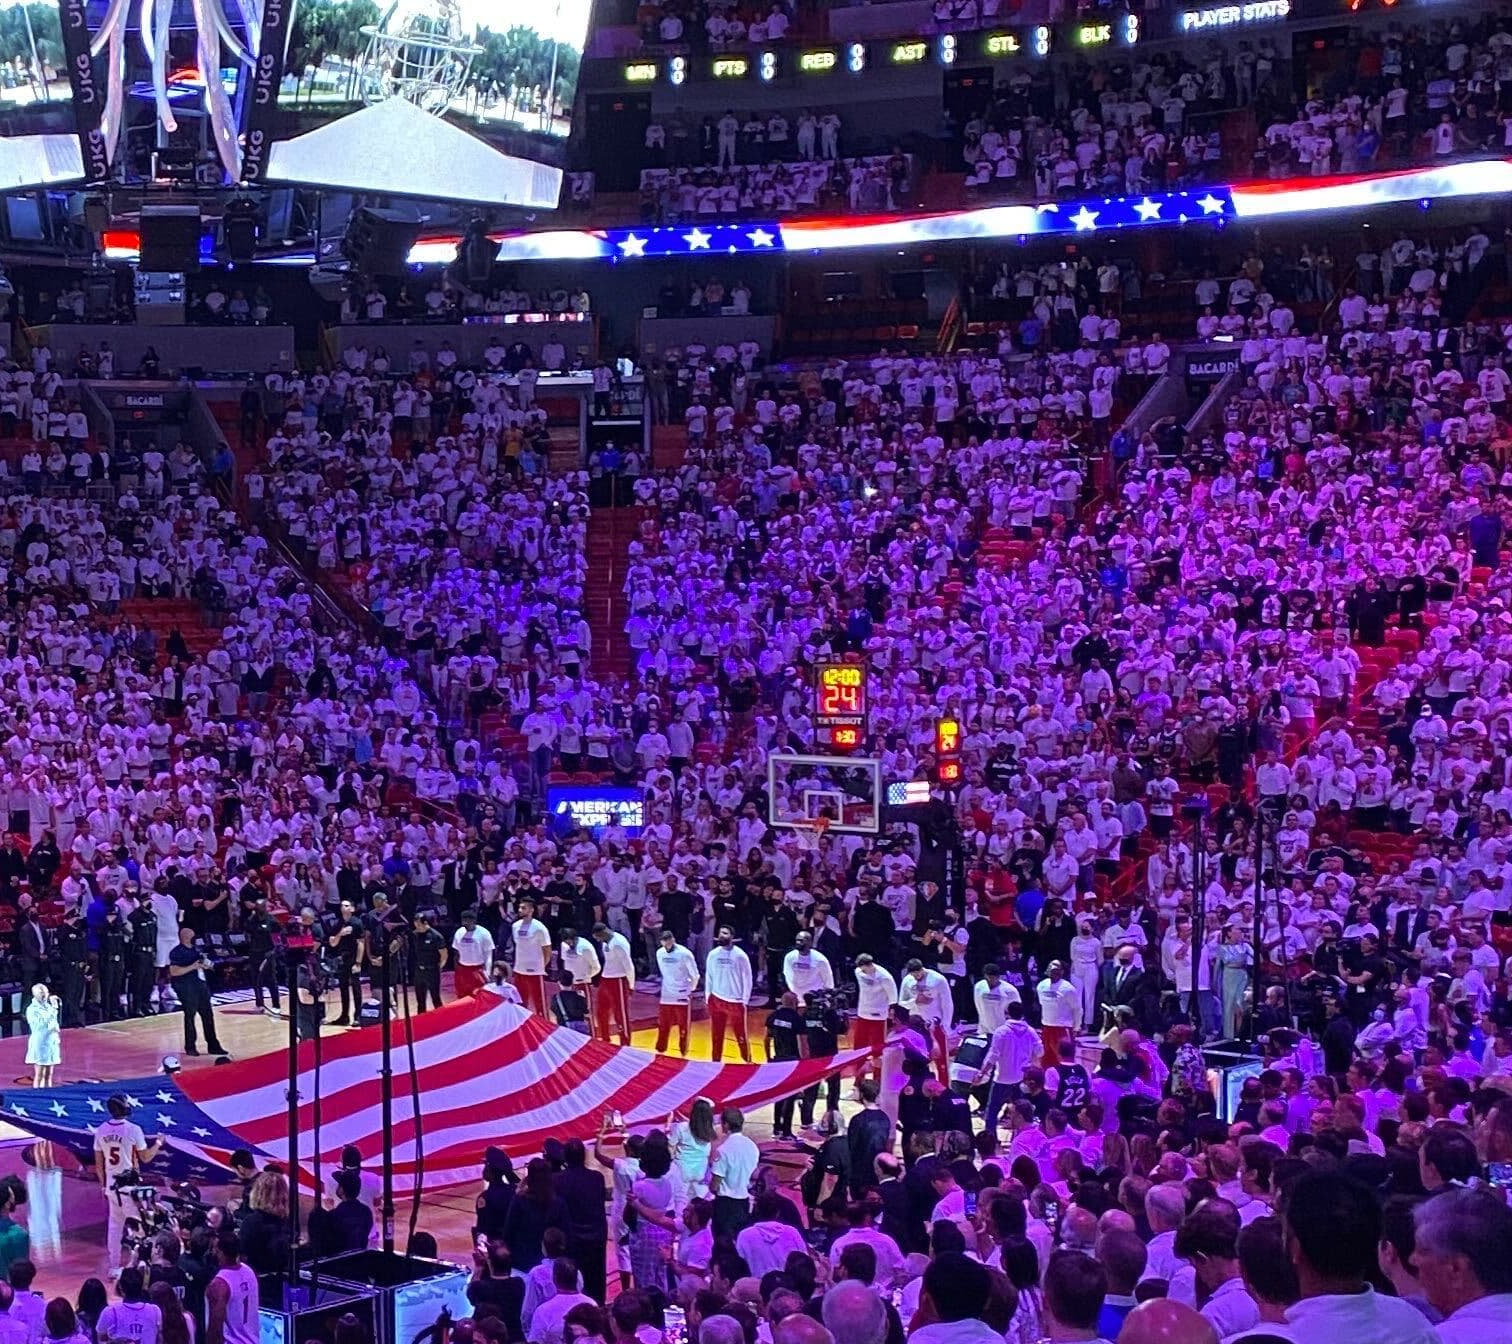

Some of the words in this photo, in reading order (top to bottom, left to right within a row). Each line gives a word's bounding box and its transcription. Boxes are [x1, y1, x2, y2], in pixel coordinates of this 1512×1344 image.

[1183, 6, 1241, 31] PLAYER
[1242, 0, 1289, 22] STATS
[988, 35, 1018, 53] STL
[1079, 24, 1111, 44] BLK
[801, 53, 834, 70] REB
[893, 43, 927, 62] AST
[77, 53, 94, 104] UKG
[256, 54, 274, 104] UKG
[713, 60, 746, 78] PTS
[88, 129, 106, 178] UKG
[245, 130, 264, 179] UKG
[823, 668, 860, 686] 12:00
[824, 686, 856, 714] 24
[831, 717, 863, 725] TISSOT
[1061, 1087, 1086, 1108] 22
[109, 1146, 120, 1165] 5
